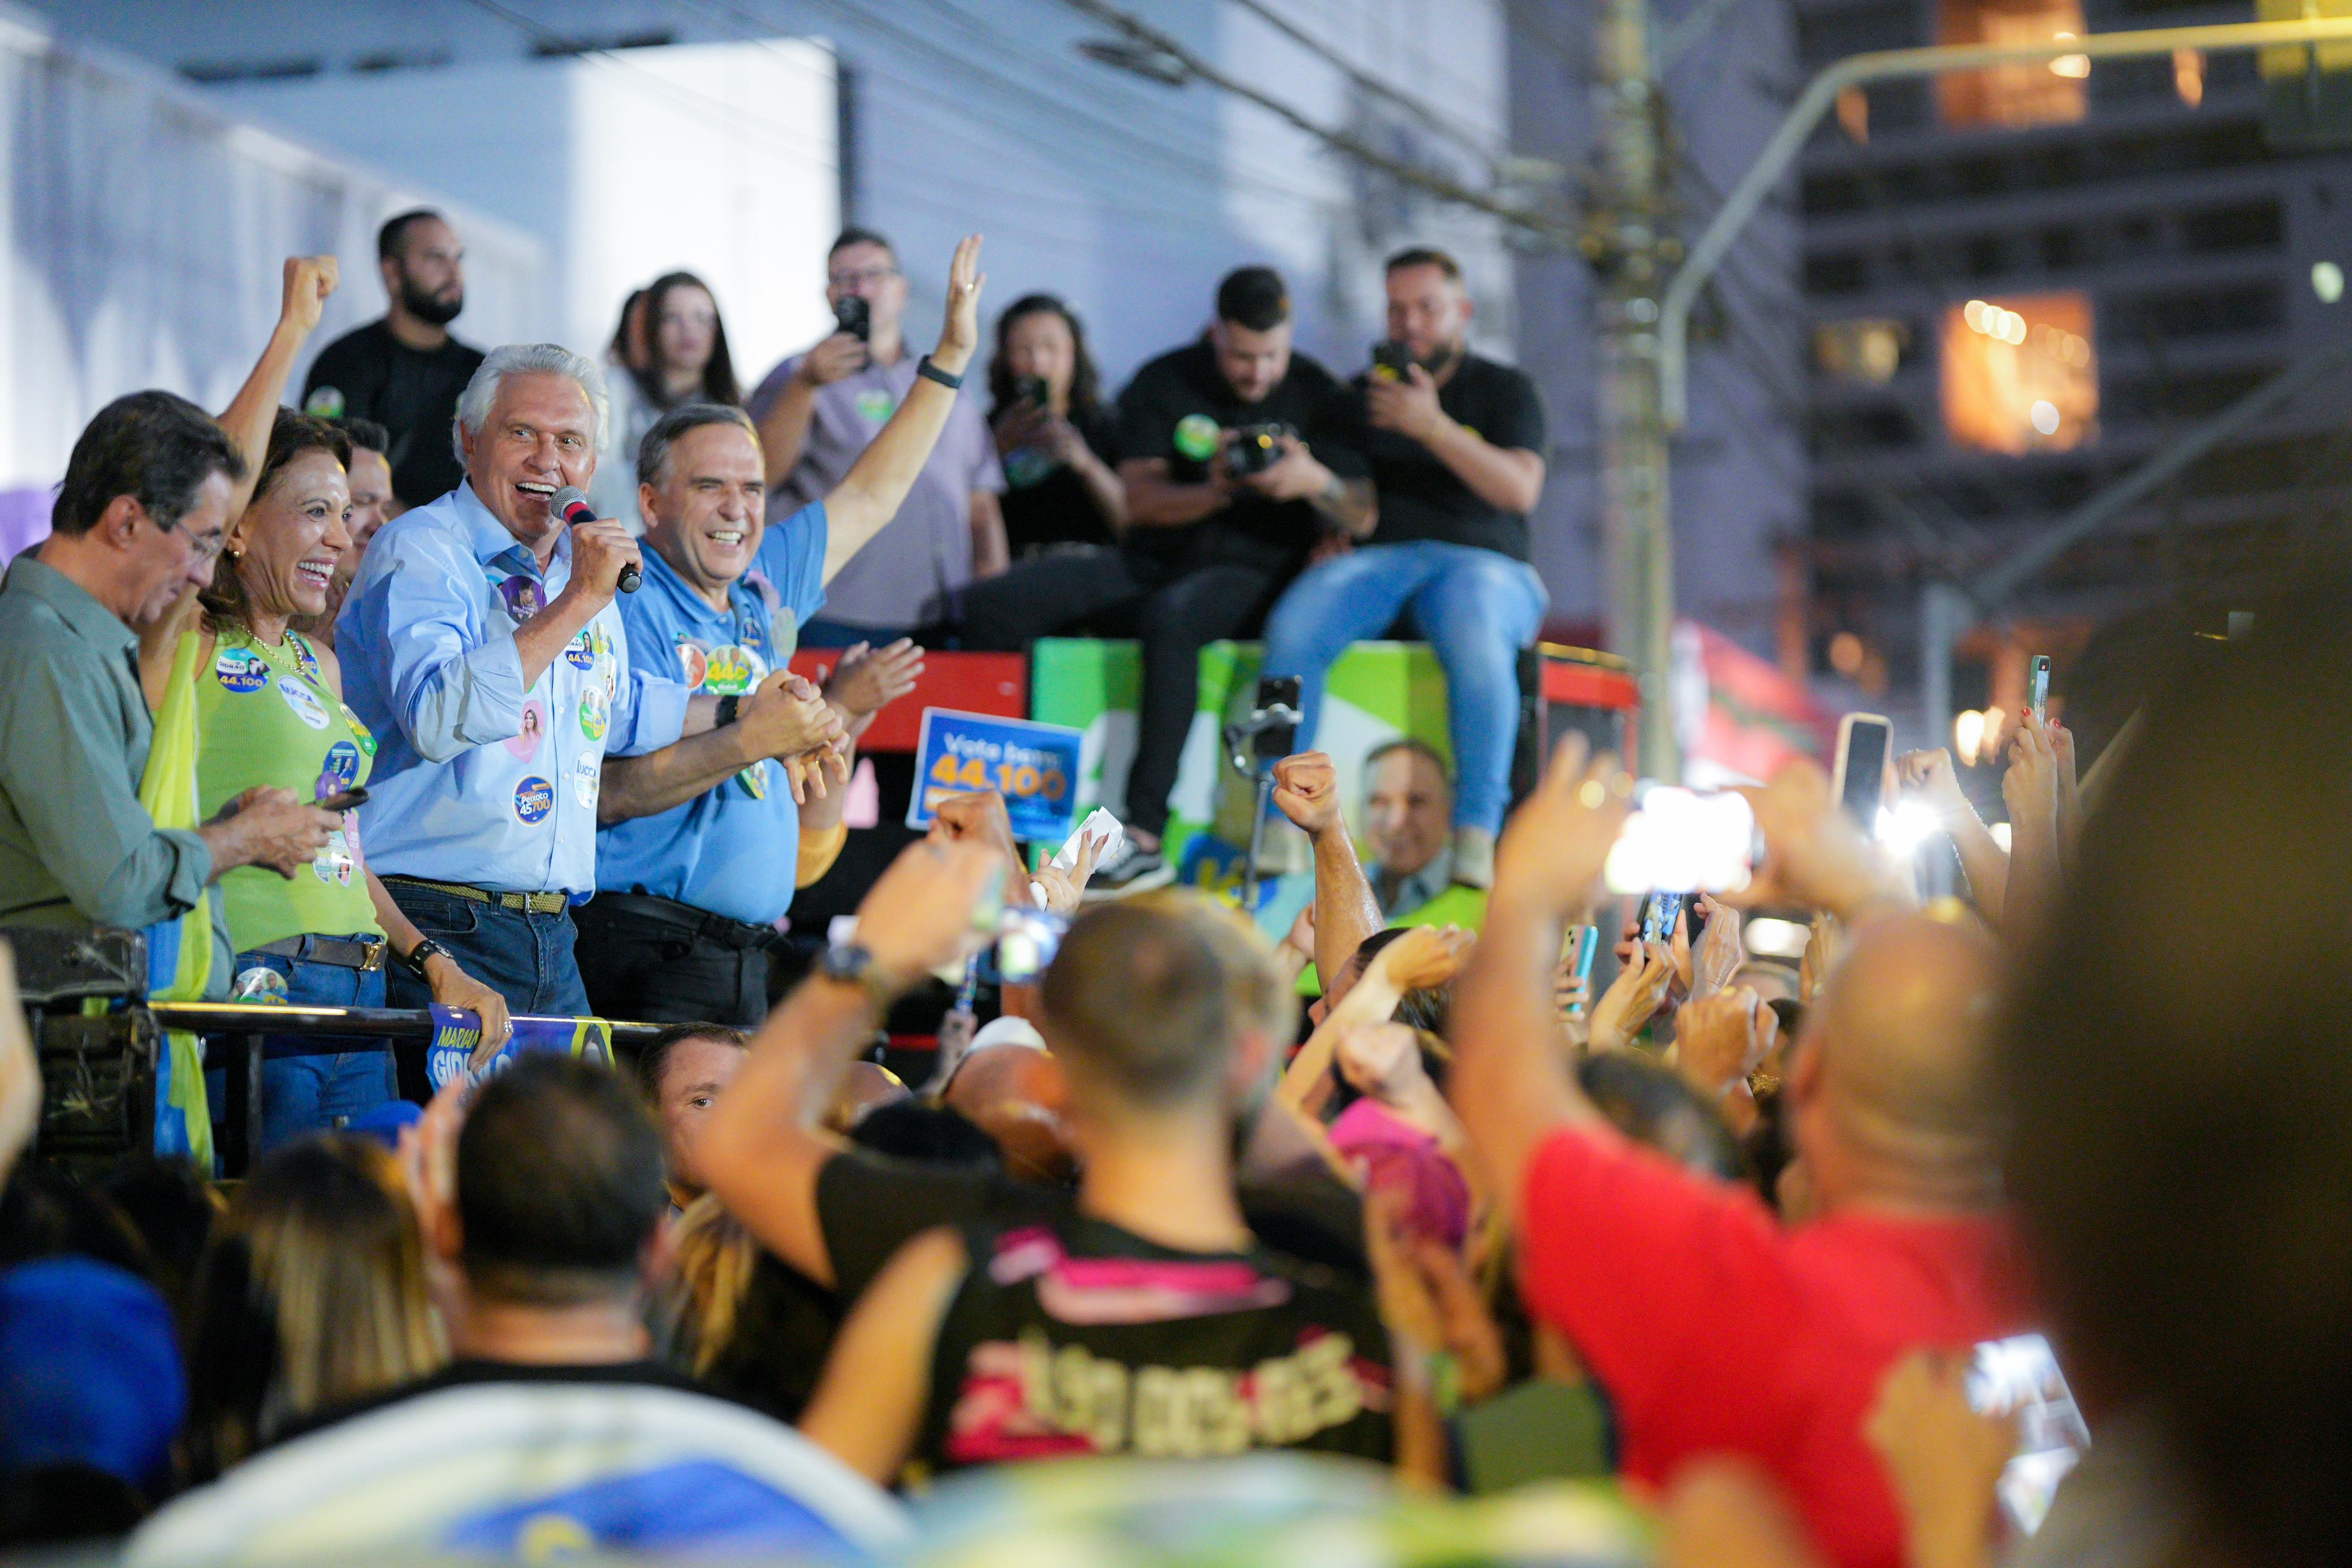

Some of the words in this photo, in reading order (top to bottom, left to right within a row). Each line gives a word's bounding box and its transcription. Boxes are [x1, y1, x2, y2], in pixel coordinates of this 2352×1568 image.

[568, 653, 593, 664] 44.100
[219, 675, 263, 687] 44.100
[943, 732, 1002, 761] Vote
[931, 754, 1067, 801] 44.100
[521, 792, 548, 804] Peixoto
[520, 799, 551, 815] 45700
